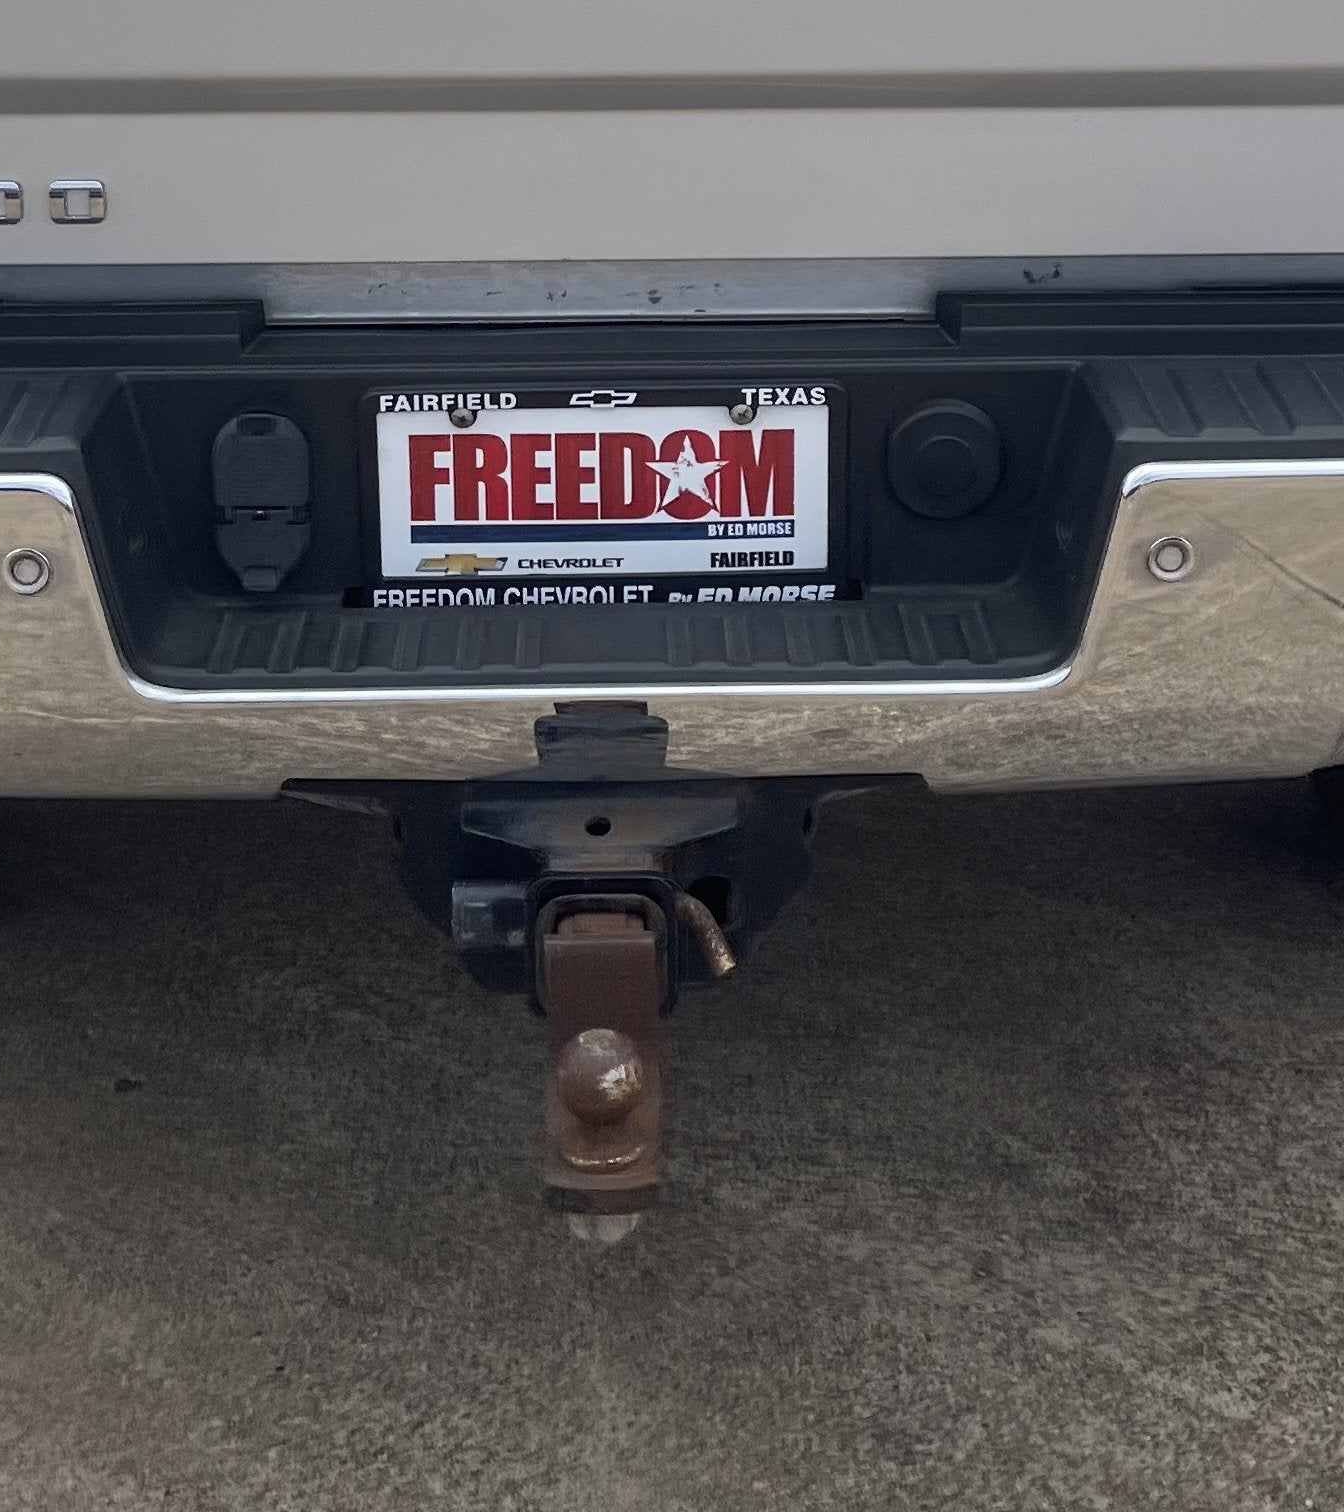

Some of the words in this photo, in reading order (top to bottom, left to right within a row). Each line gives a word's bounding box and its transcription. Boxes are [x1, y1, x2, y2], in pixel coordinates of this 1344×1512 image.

[379, 393, 517, 412] FAIRFIELD
[741, 387, 827, 406] TEXAS
[408, 428, 796, 521] FREEDOM
[708, 524, 724, 537] BY
[727, 523, 744, 536] ED
[746, 522, 792, 536] MORSE
[517, 557, 625, 570] CHEVROLET
[710, 550, 795, 569] FAIRFIELD
